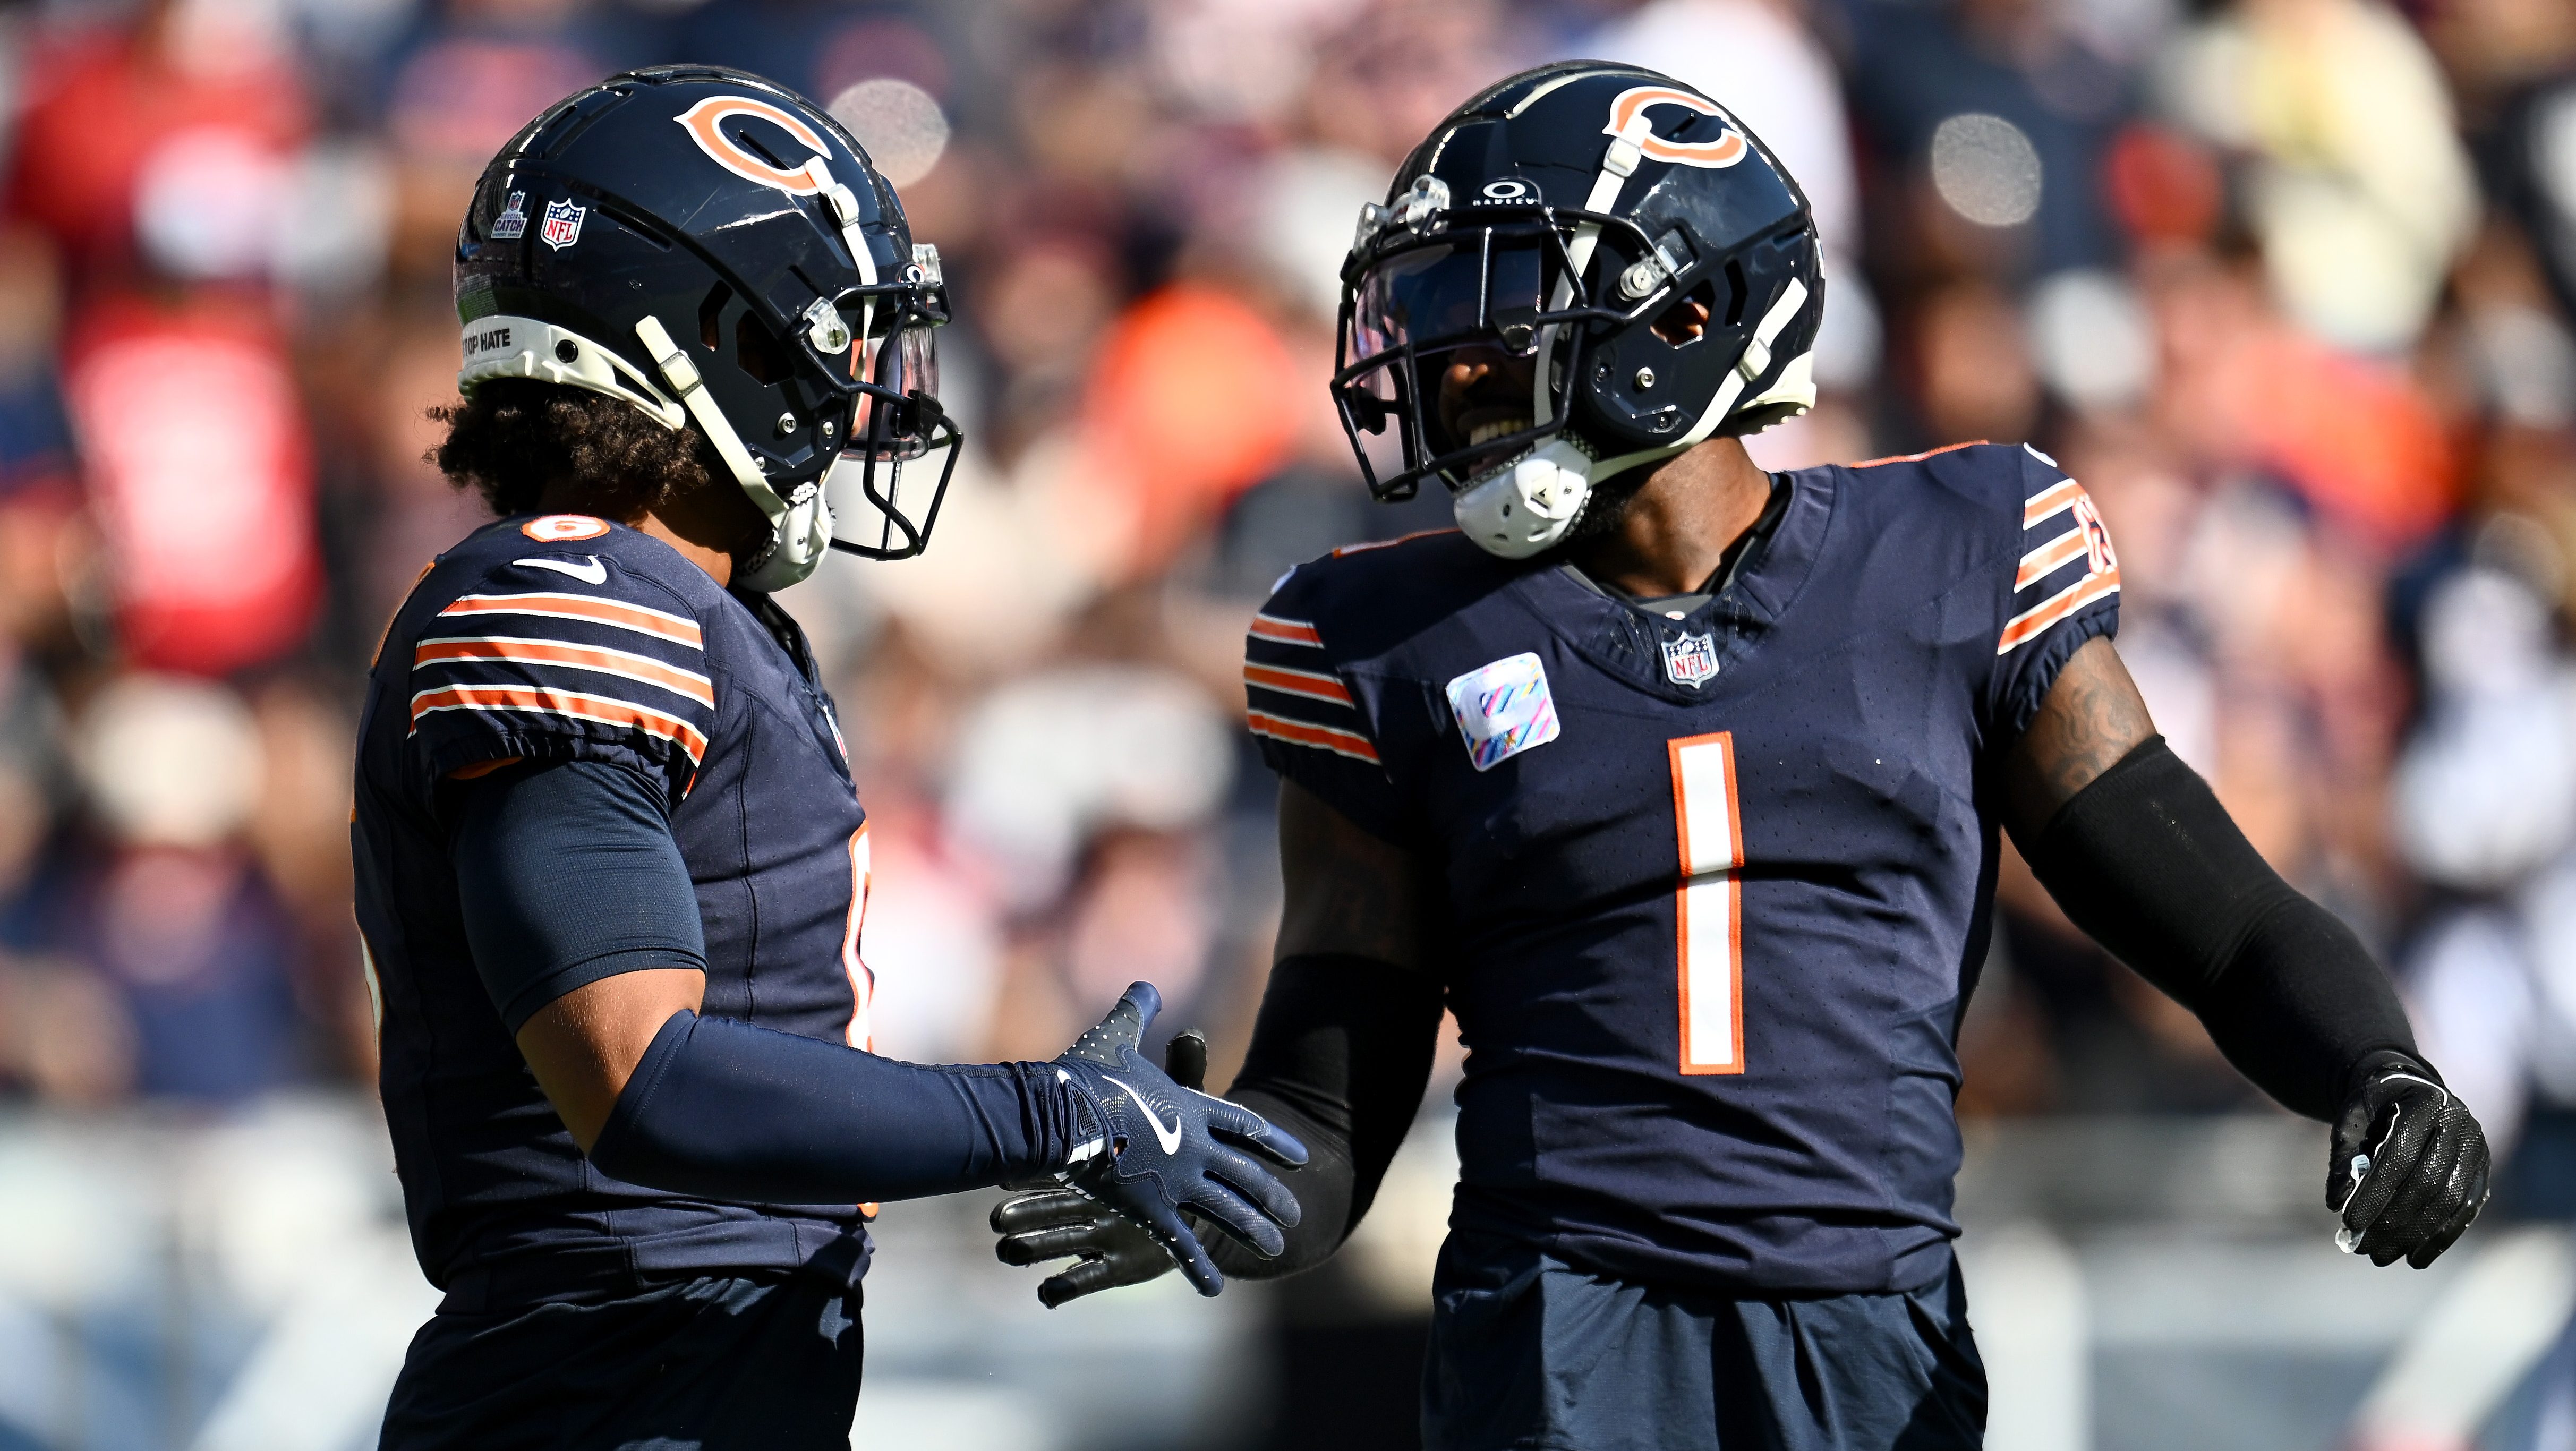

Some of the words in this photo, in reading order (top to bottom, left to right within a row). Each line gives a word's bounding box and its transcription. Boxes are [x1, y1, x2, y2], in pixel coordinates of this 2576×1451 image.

[1601, 86, 1747, 169] C
[673, 96, 832, 197] C
[494, 220, 525, 231] CATCH
[545, 220, 572, 242] NFL
[463, 335, 478, 357] TOP
[480, 328, 510, 352] HATE
[1675, 654, 1708, 677] NFL
[1667, 730, 1745, 1075] 1
